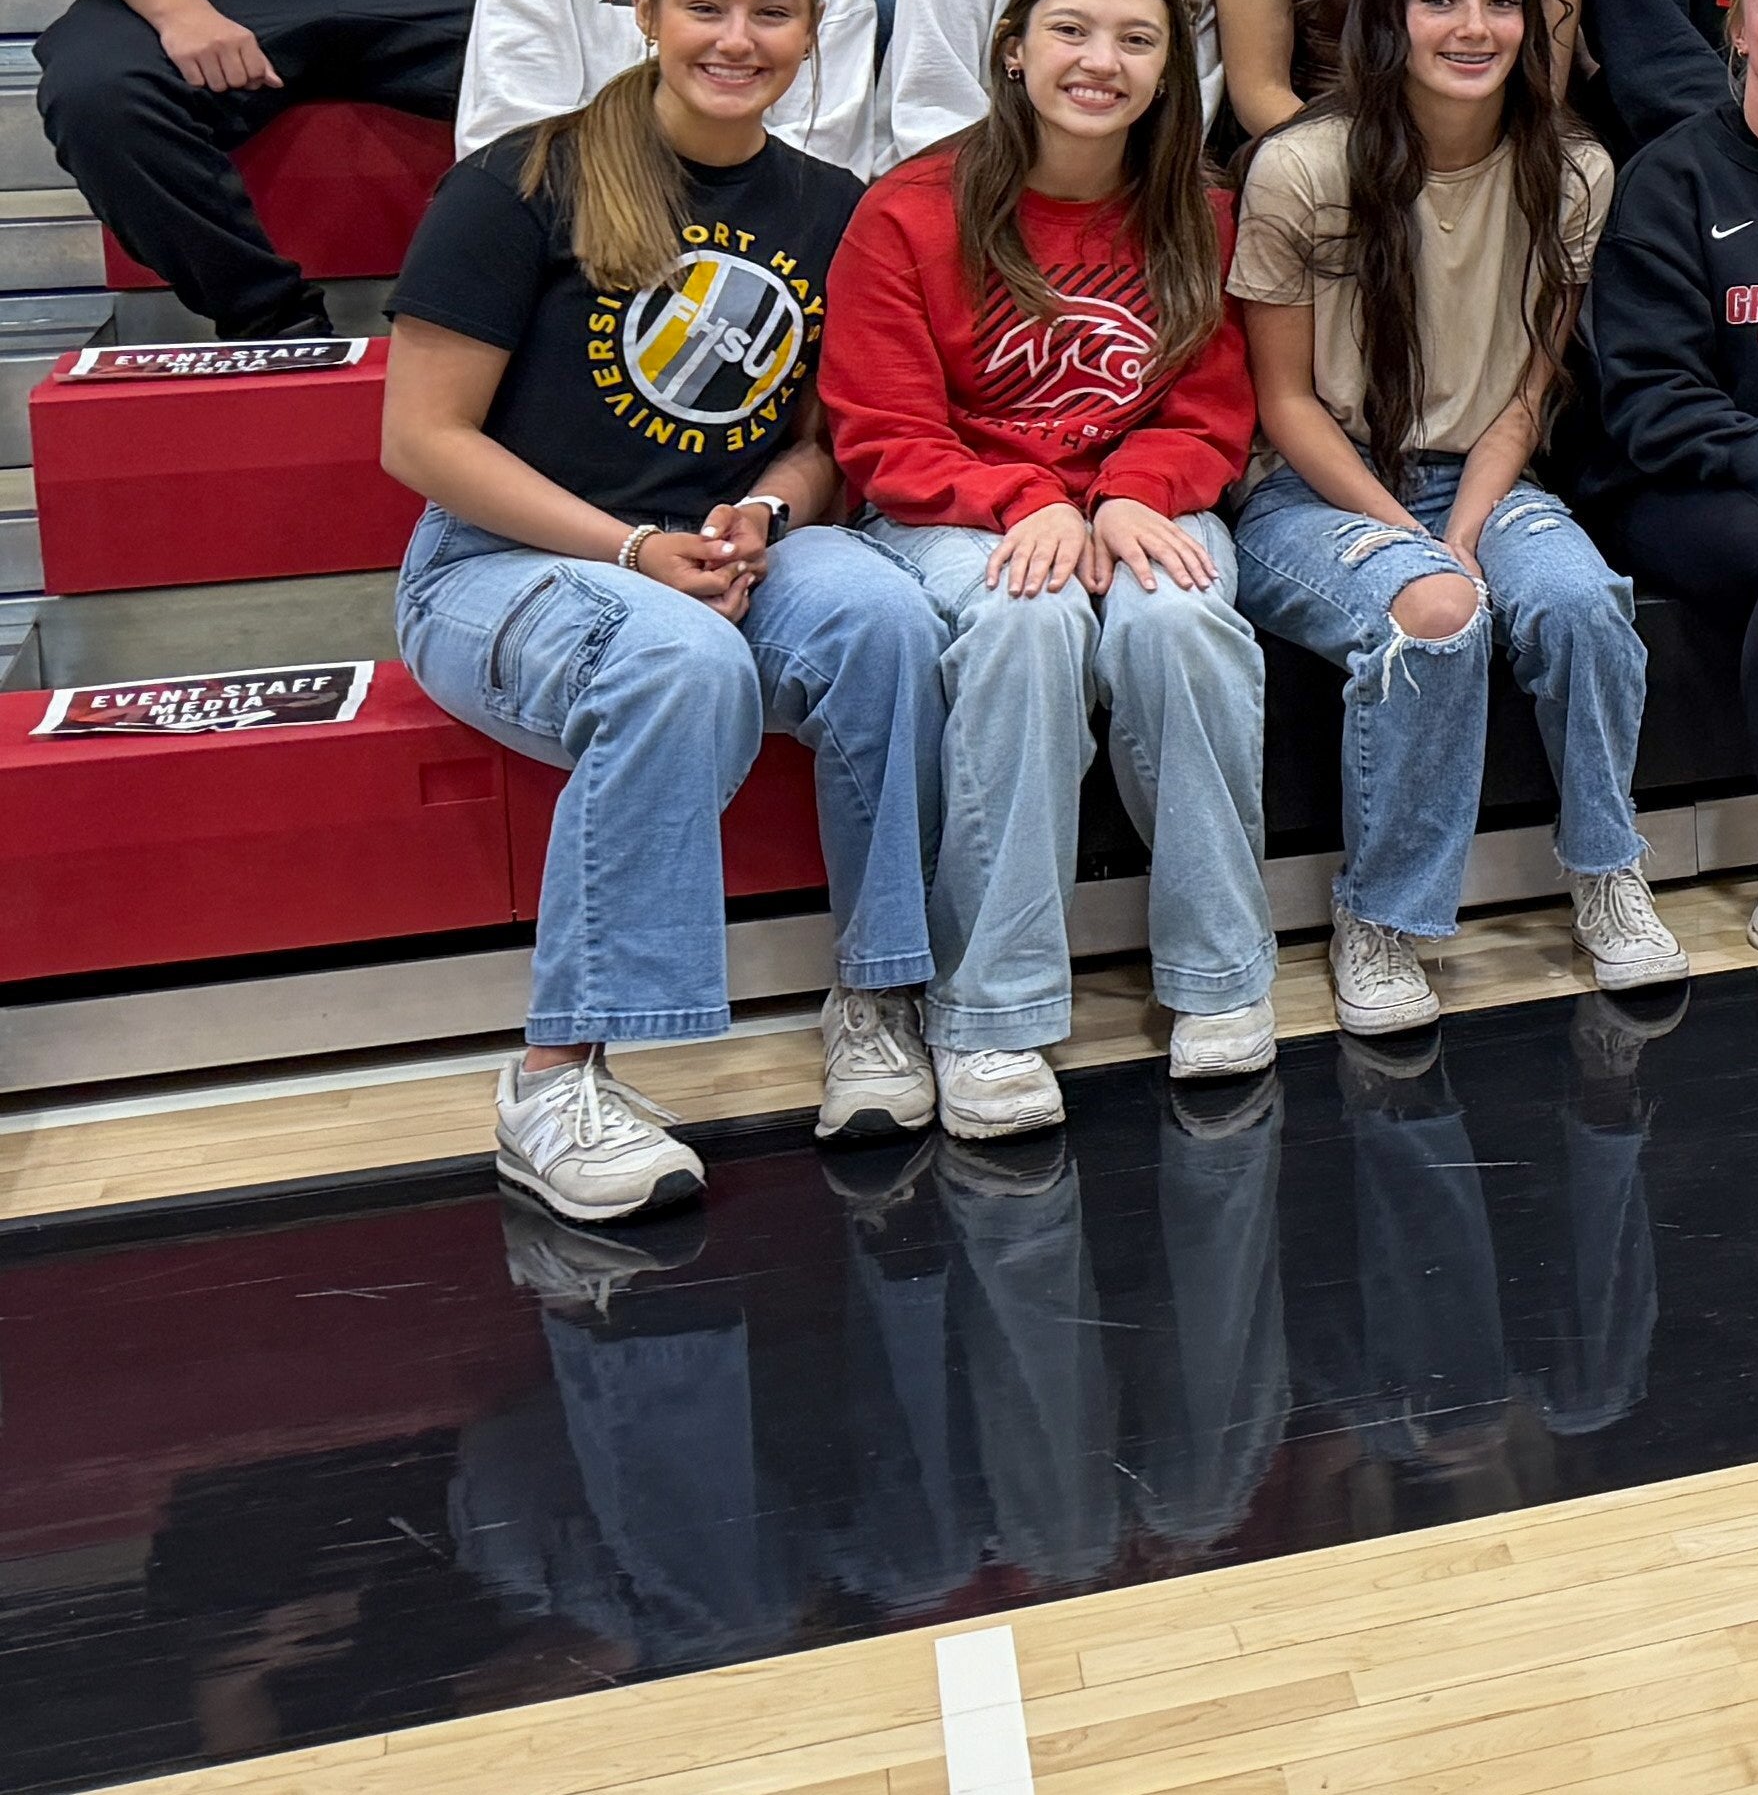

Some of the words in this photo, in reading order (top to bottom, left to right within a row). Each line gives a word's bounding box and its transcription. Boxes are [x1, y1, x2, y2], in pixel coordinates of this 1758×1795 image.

[683, 222, 755, 252] ORT
[771, 250, 824, 342] HAYS
[115, 352, 218, 366] EVENT
[230, 346, 331, 360] STAFF
[91, 687, 207, 709] EVENT
[221, 676, 333, 698] STAFF
[149, 695, 263, 716] MEDIA
